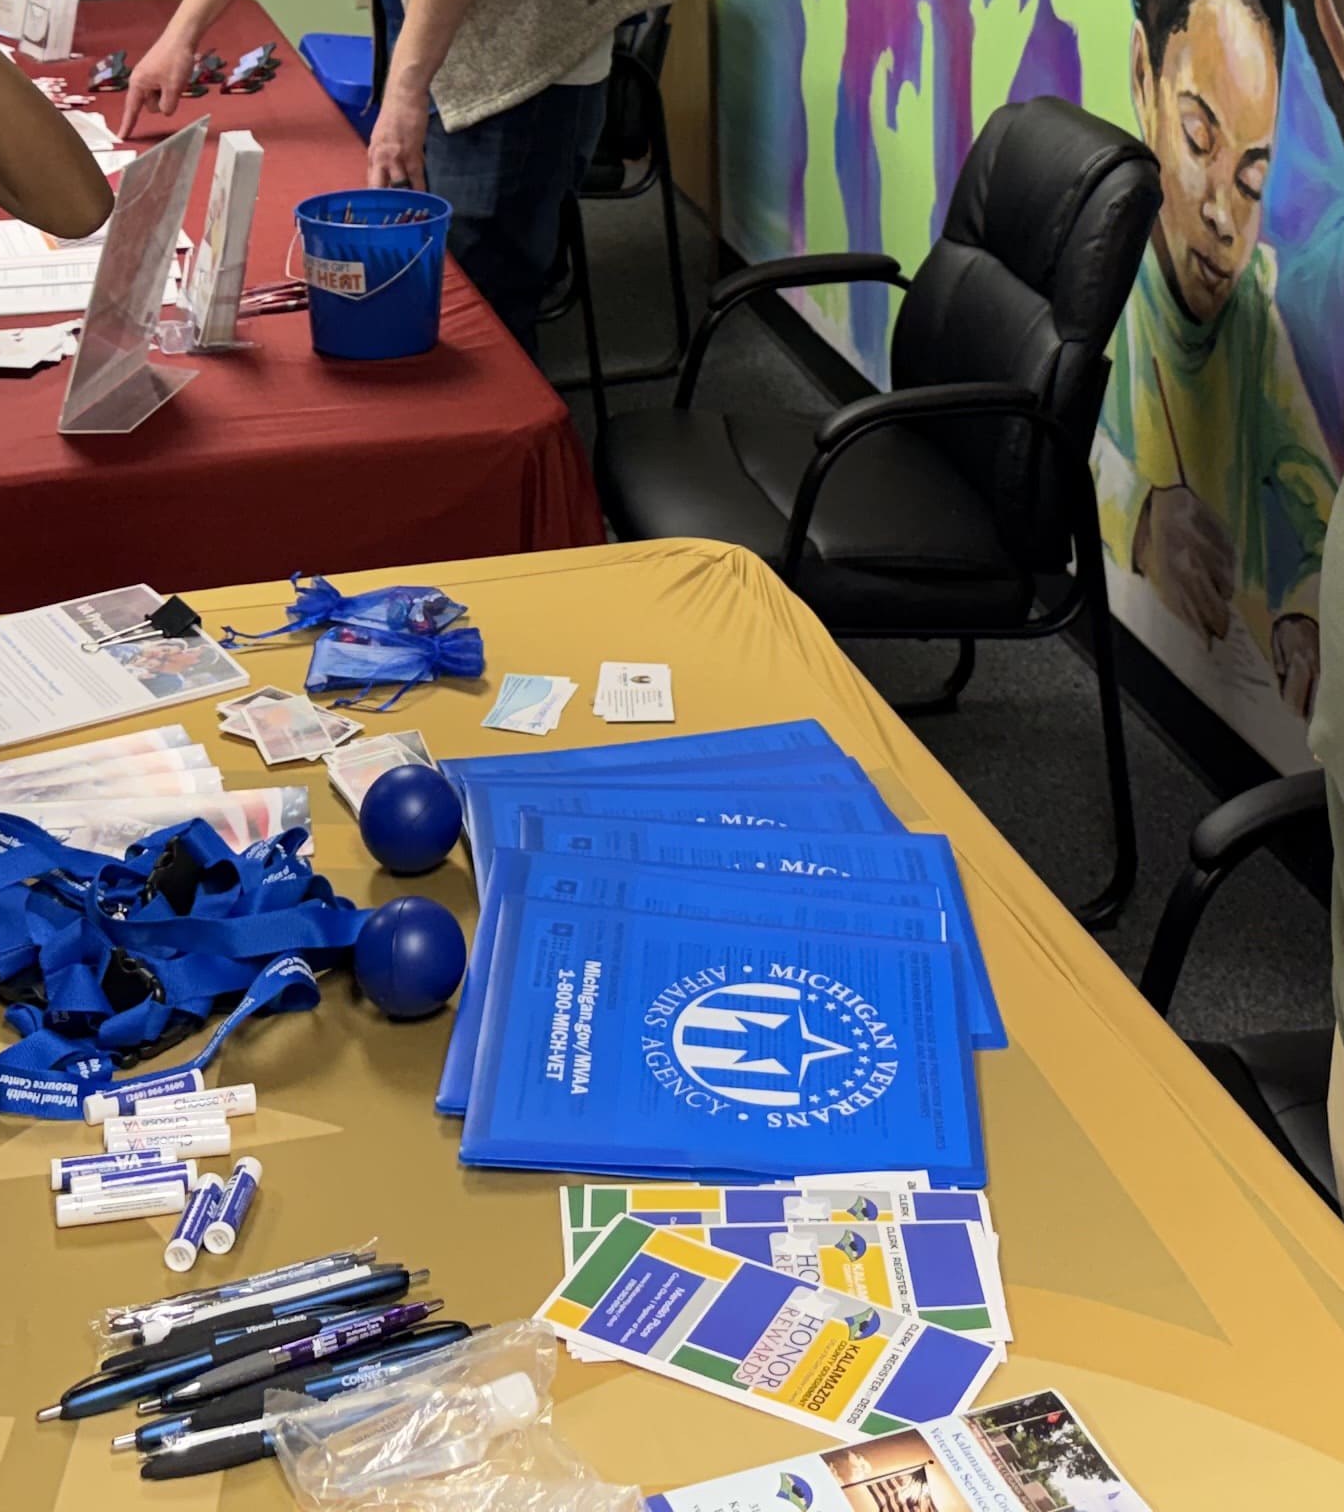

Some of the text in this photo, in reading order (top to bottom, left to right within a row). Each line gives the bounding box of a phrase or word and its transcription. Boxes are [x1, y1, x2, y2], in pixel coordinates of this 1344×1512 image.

[545, 967, 577, 1082] 1-800-MICH-VET
[641, 964, 733, 1119] AFFAIRS AGENCY
[766, 961, 900, 1130] MICHIGAN VETERANS
[5, 1088, 78, 1108] Virtual Health
[899, 1193, 910, 1217] CLERK
[886, 1226, 898, 1249] CLERK
[735, 1305, 796, 1385] REWARDS
[756, 1313, 824, 1389] HONOR
[901, 1323, 920, 1347] CLERK
[807, 1344, 861, 1412] KALAMAZOO
[870, 1353, 900, 1392] REGISTER
[846, 1398, 871, 1425] DEEDS
[952, 1430, 997, 1494] Kalamazoo
